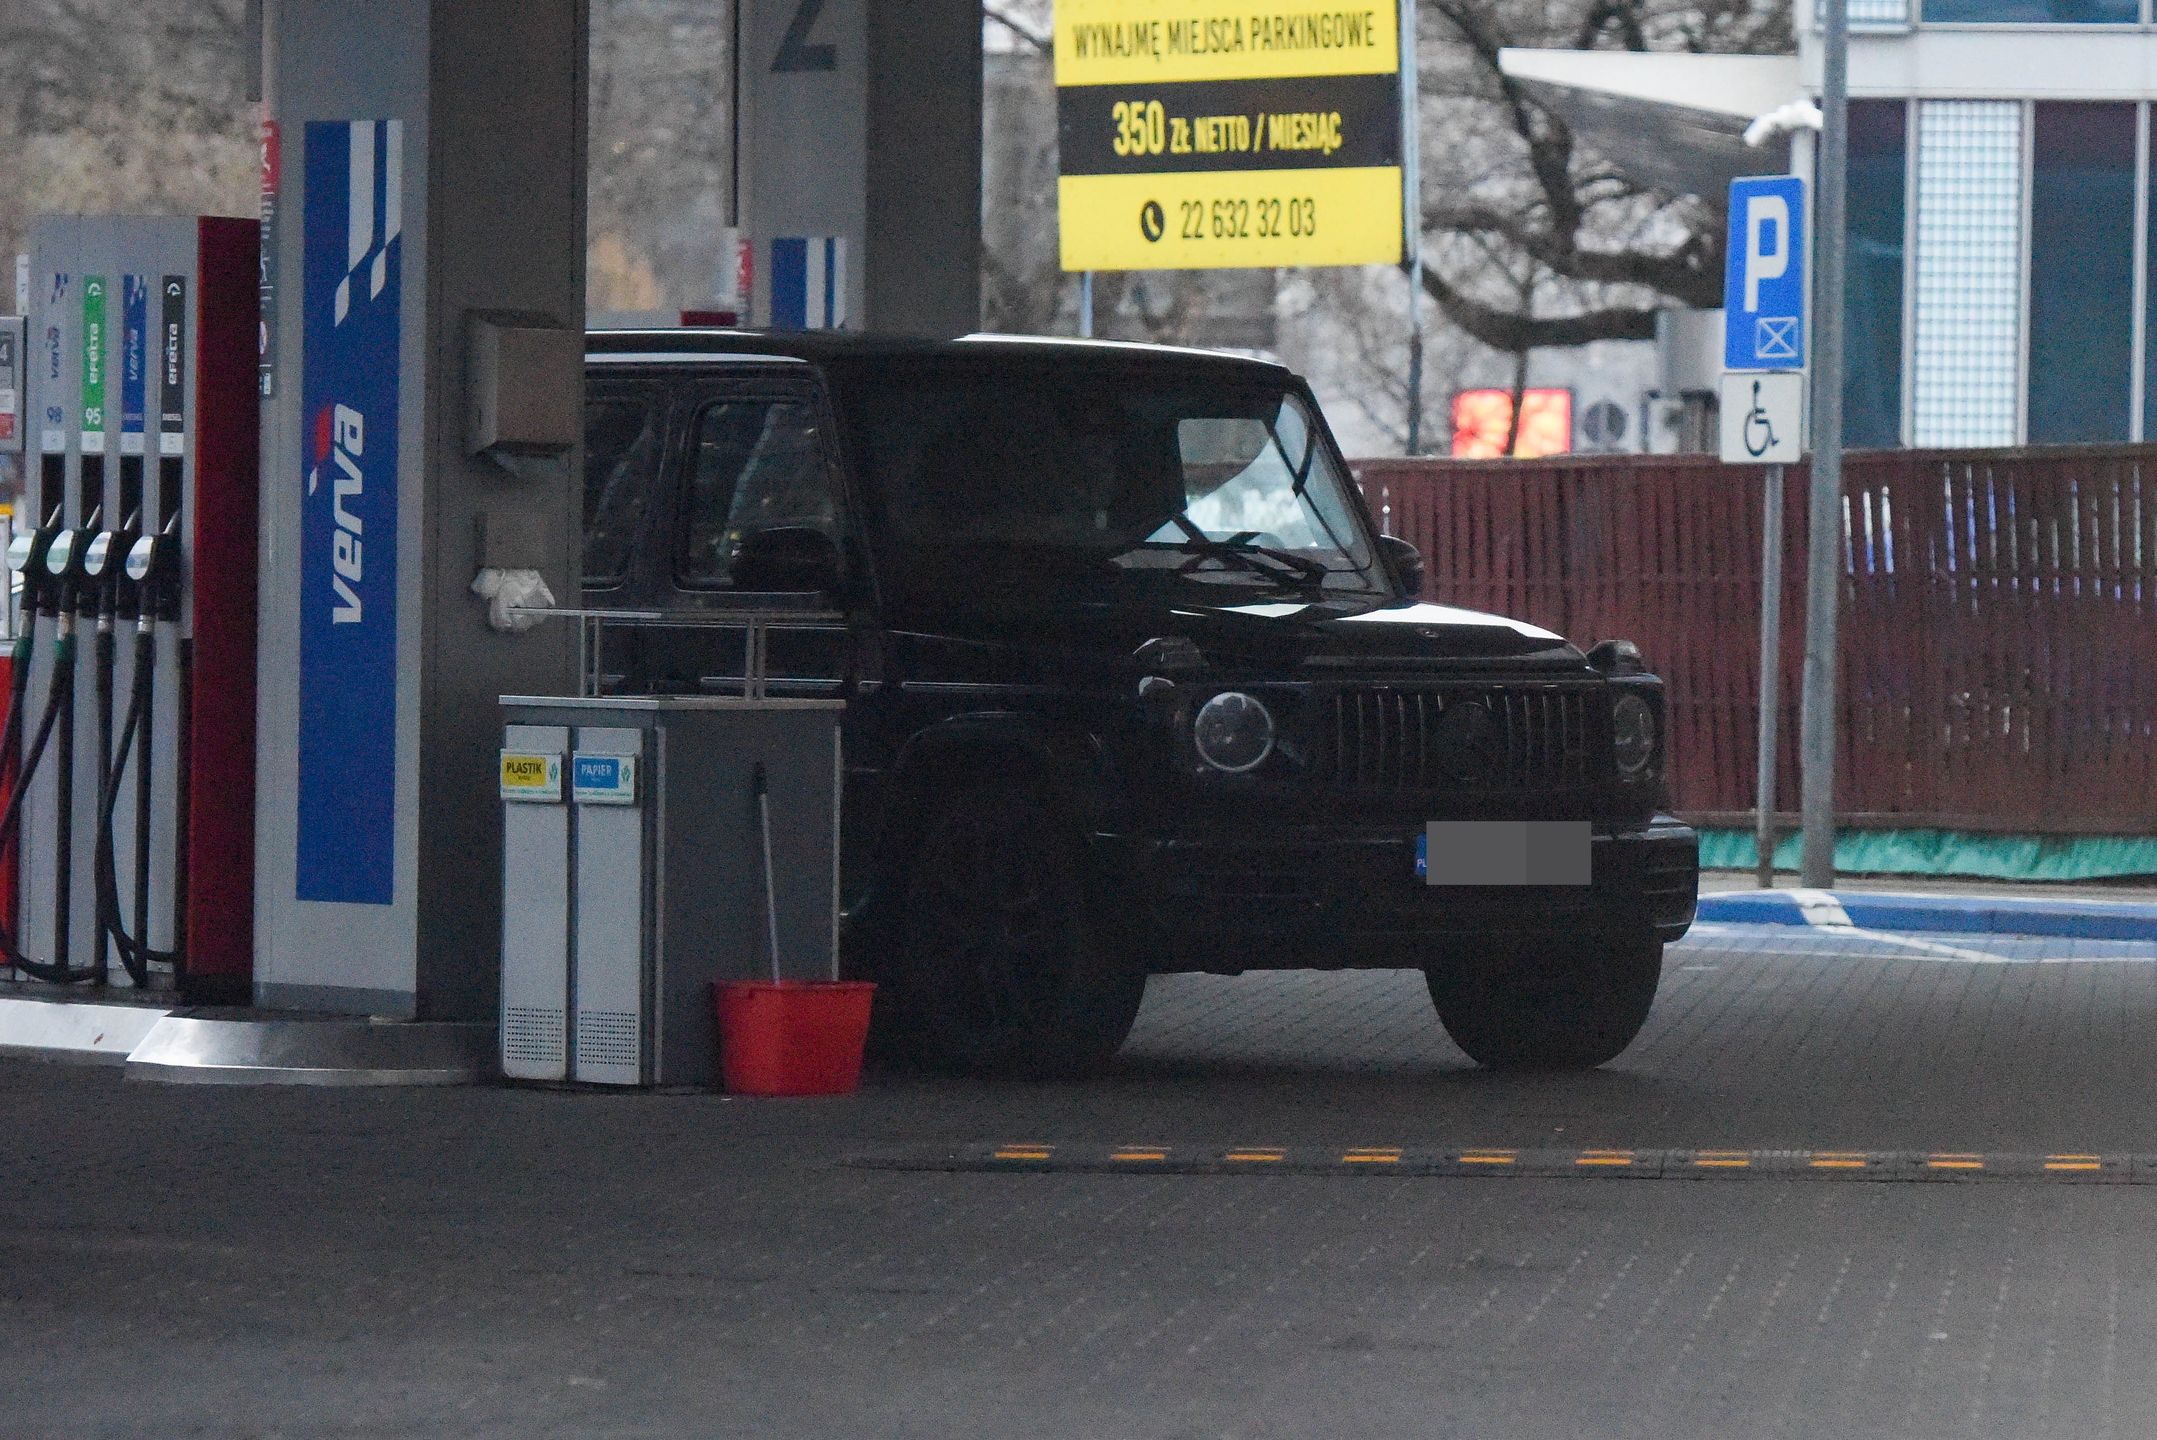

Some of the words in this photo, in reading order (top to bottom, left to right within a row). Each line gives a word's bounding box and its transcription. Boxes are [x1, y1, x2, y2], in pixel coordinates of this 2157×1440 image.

[1072, 20, 1161, 63] WYNAJMĘ
[1167, 16, 1246, 55] MIEJSCA
[1251, 11, 1376, 51] PARKINGOWE
[1112, 100, 1165, 156] 350
[1169, 117, 1192, 154] ZŁ
[1195, 115, 1250, 153] NETTO
[1254, 112, 1265, 153] /
[1268, 111, 1343, 155] MIESIĄC
[1180, 200, 1204, 239] 22
[1212, 199, 1248, 238] 632
[1257, 198, 1281, 237] 32
[1289, 197, 1316, 237] 03
[1743, 194, 1790, 313] P
[47, 406, 63, 423] 98
[85, 407, 102, 425] 95
[332, 403, 364, 625] verva
[506, 762, 543, 775] PLASTIK
[580, 764, 612, 777] PAPIER
